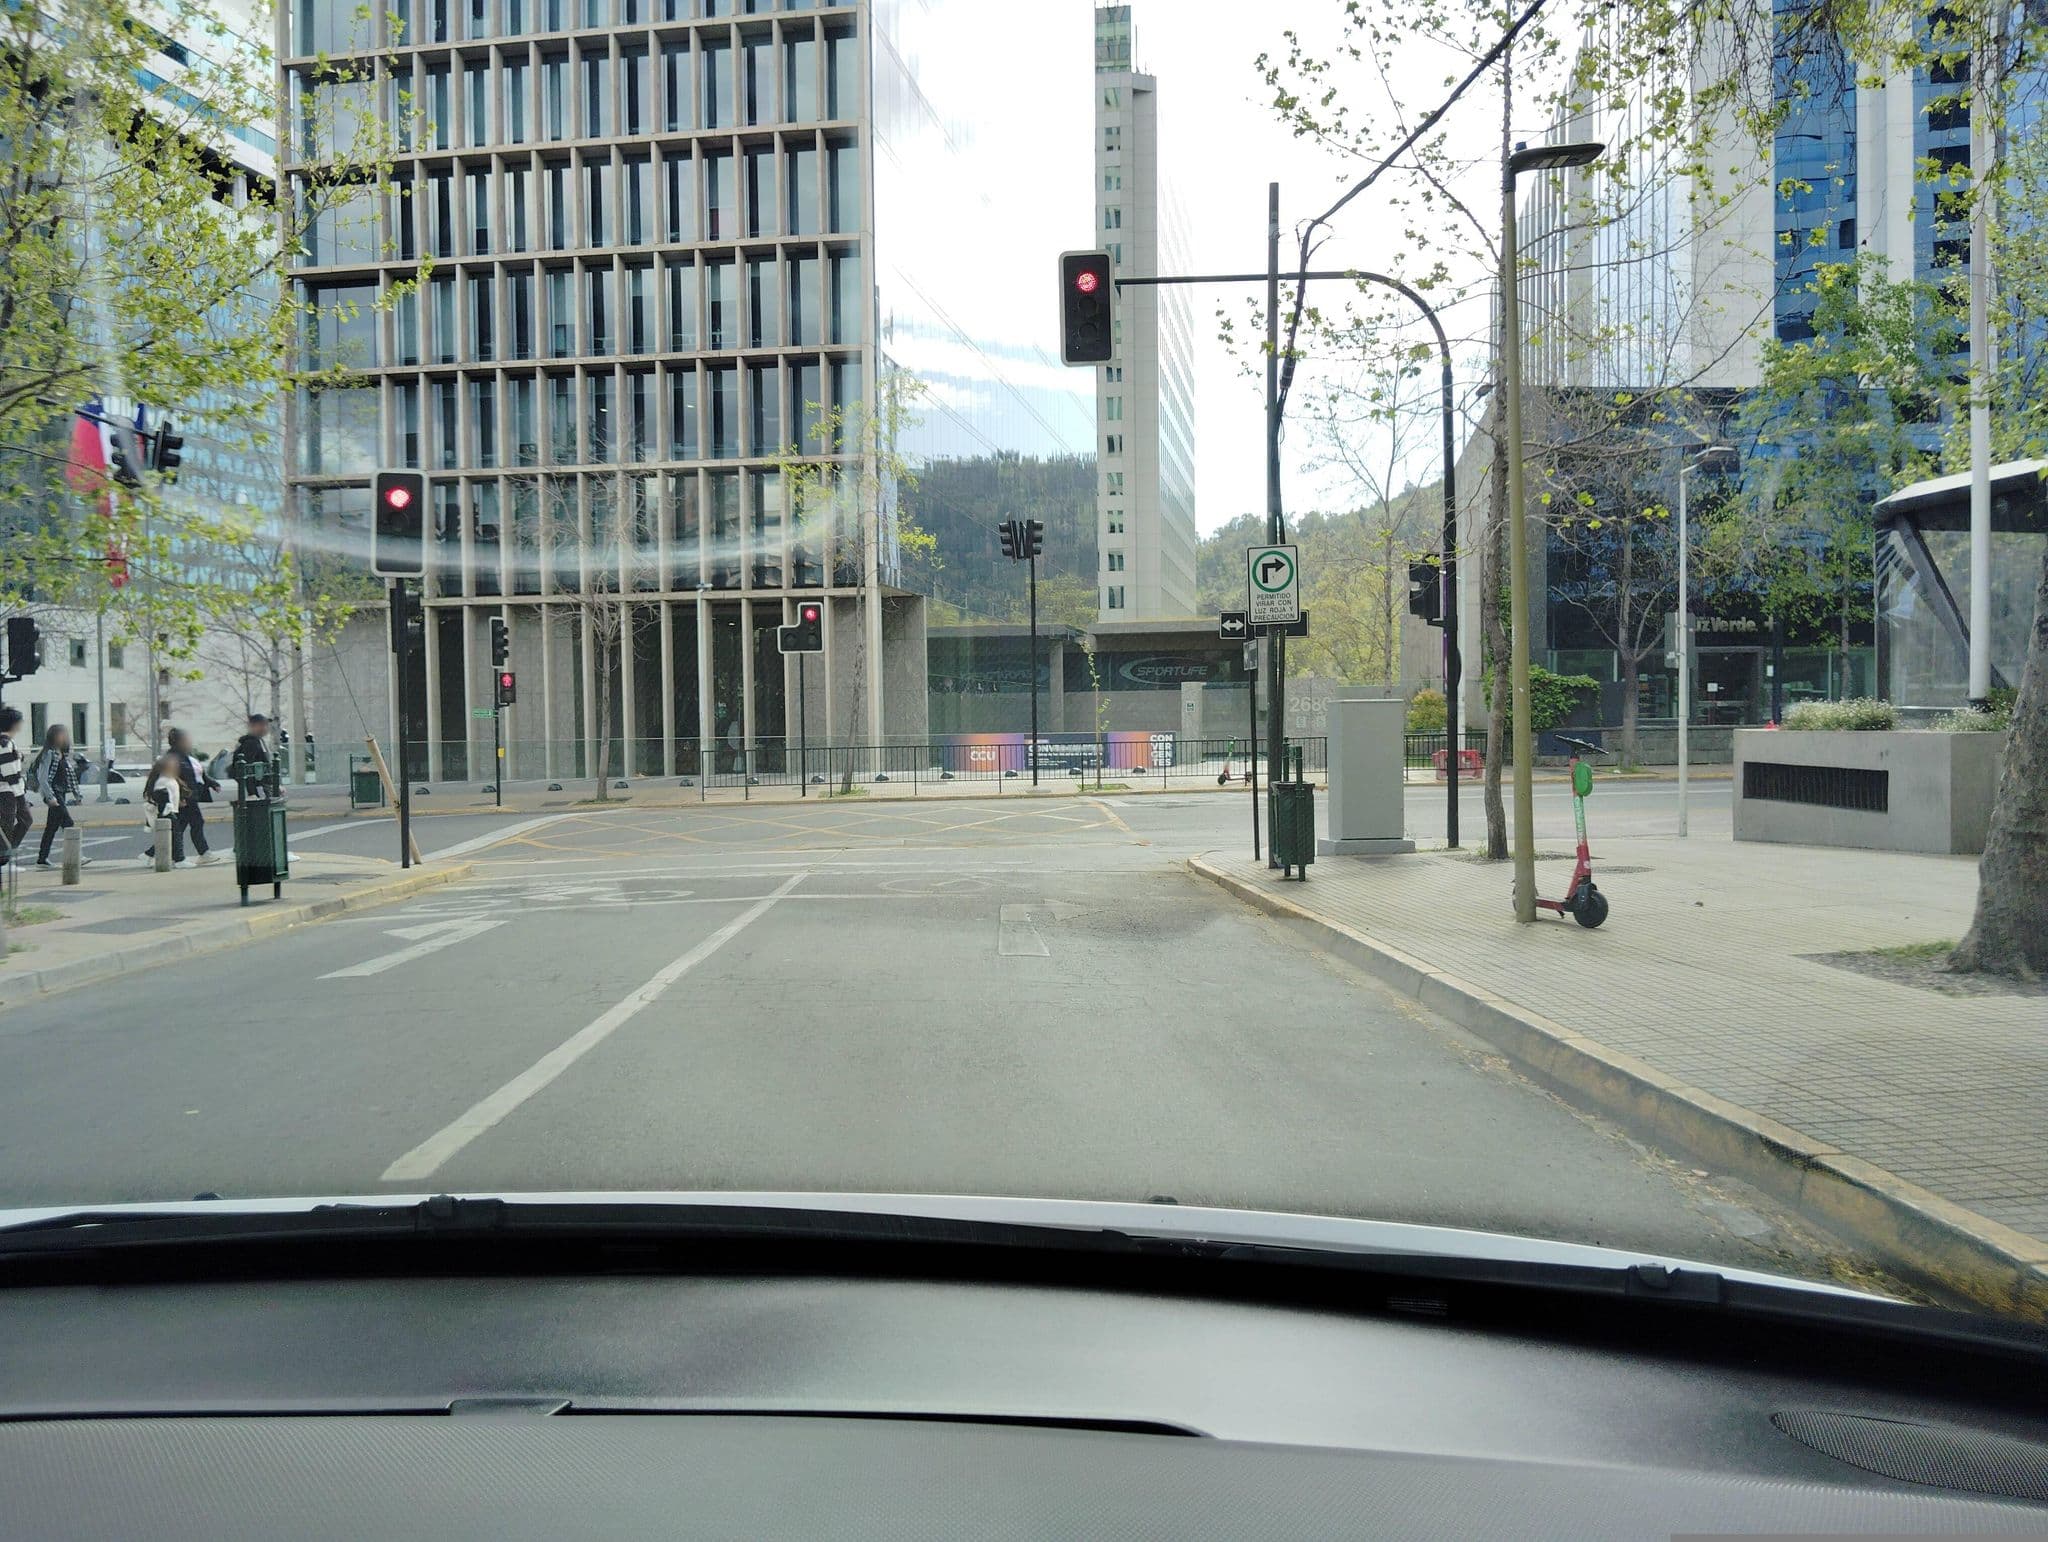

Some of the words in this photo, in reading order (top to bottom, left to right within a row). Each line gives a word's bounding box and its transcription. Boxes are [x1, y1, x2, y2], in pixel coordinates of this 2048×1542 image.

[1150, 734, 1173, 742] CON
[1151, 750, 1173, 758] GEN
[1152, 758, 1172, 766] TES
